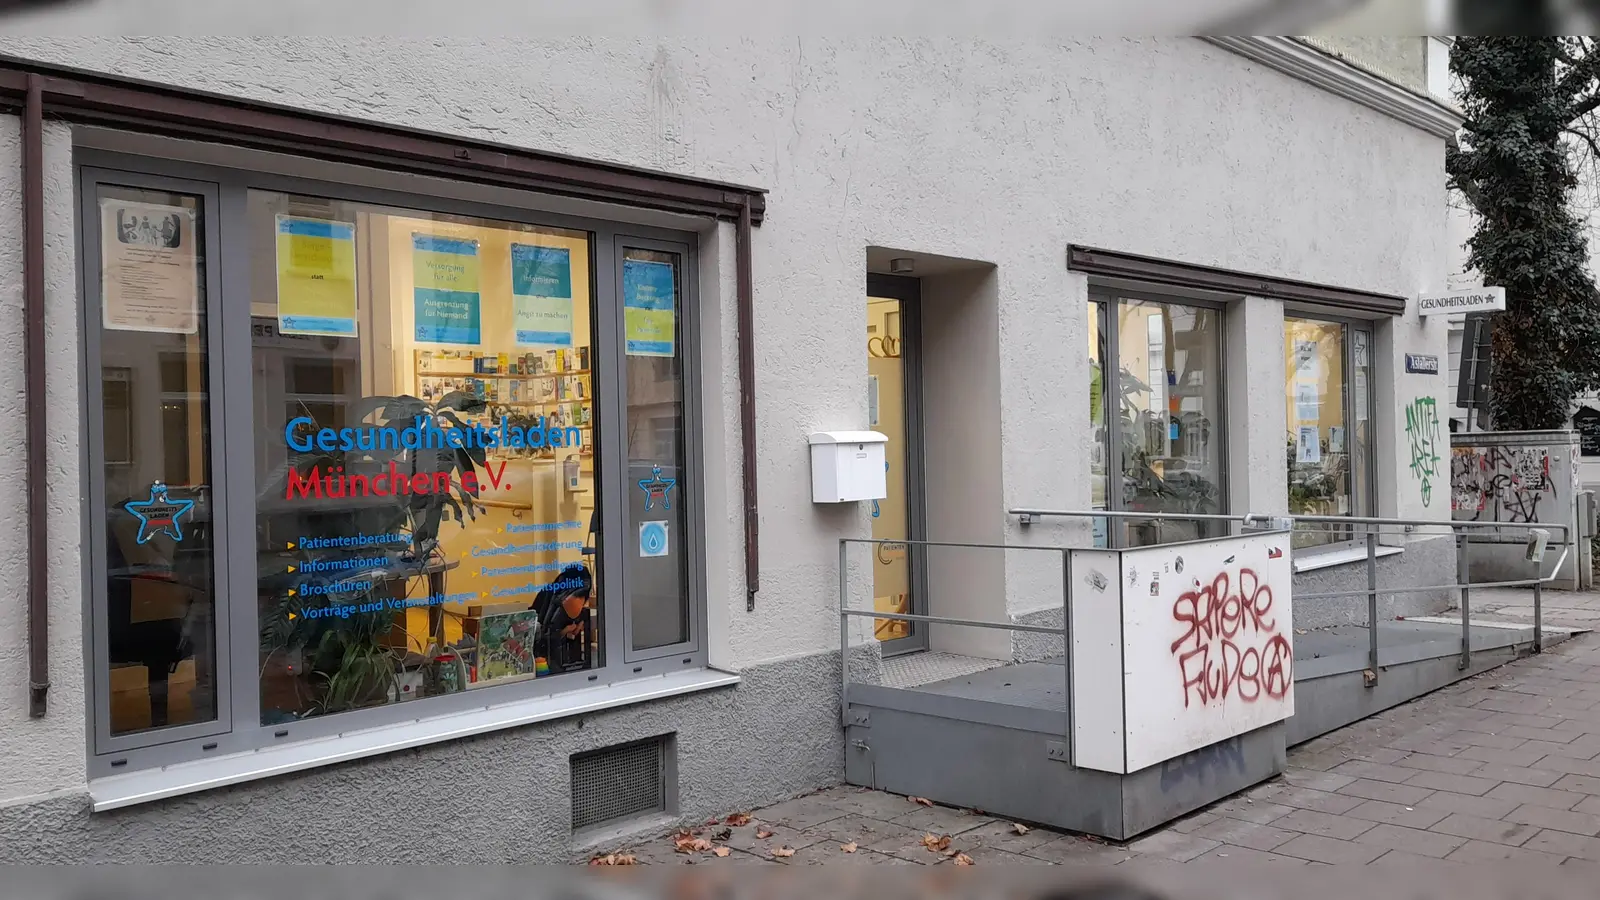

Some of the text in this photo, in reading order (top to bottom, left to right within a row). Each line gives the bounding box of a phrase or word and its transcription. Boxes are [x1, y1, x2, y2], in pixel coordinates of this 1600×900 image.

[426, 261, 465, 274] Versorgung
[424, 299, 469, 310] Ausgrenzung
[1421, 295, 1484, 309] GESUNDHEITSLADEN
[437, 311, 469, 320] Niemand
[517, 309, 535, 319] Angst
[543, 311, 568, 319] machen
[285, 415, 581, 453] Gesundheitsladen
[285, 461, 512, 500] München e.V.
[299, 532, 413, 549] Patientenberatung
[300, 555, 389, 573] Informationen
[300, 580, 371, 597] Broschüren
[491, 577, 584, 598] Gesundheitspolitik
[301, 590, 477, 620] Vorträge und Veranstaltungen
